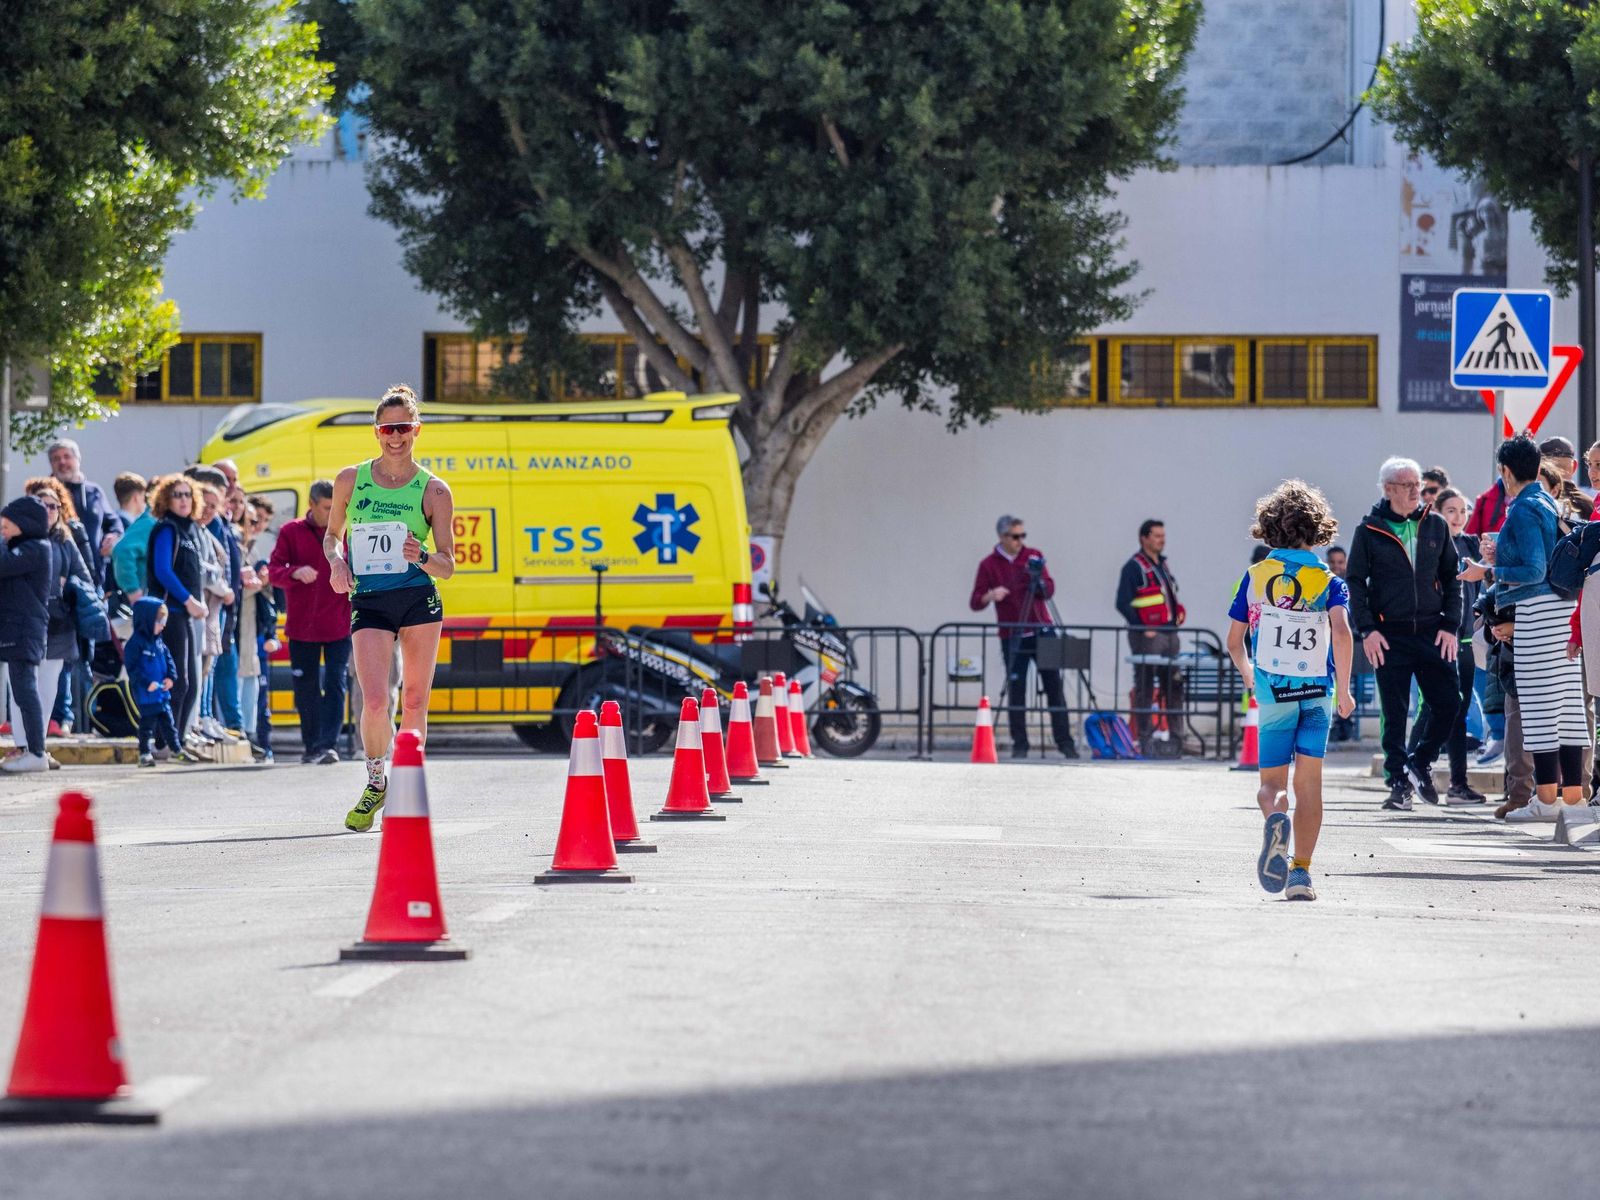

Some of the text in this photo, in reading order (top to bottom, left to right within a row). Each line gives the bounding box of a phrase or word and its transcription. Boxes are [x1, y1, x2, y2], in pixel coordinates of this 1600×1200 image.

[1414, 298, 1452, 317] jornad
[420, 456, 632, 471] RTE VITAL AVANZADO
[372, 504, 402, 516] Unicaja
[374, 500, 413, 512] Fundación
[367, 534, 392, 554] 70
[524, 526, 603, 553] TSS
[523, 556, 638, 567] Servicios Sanitarios
[1272, 625, 1317, 650] 143
